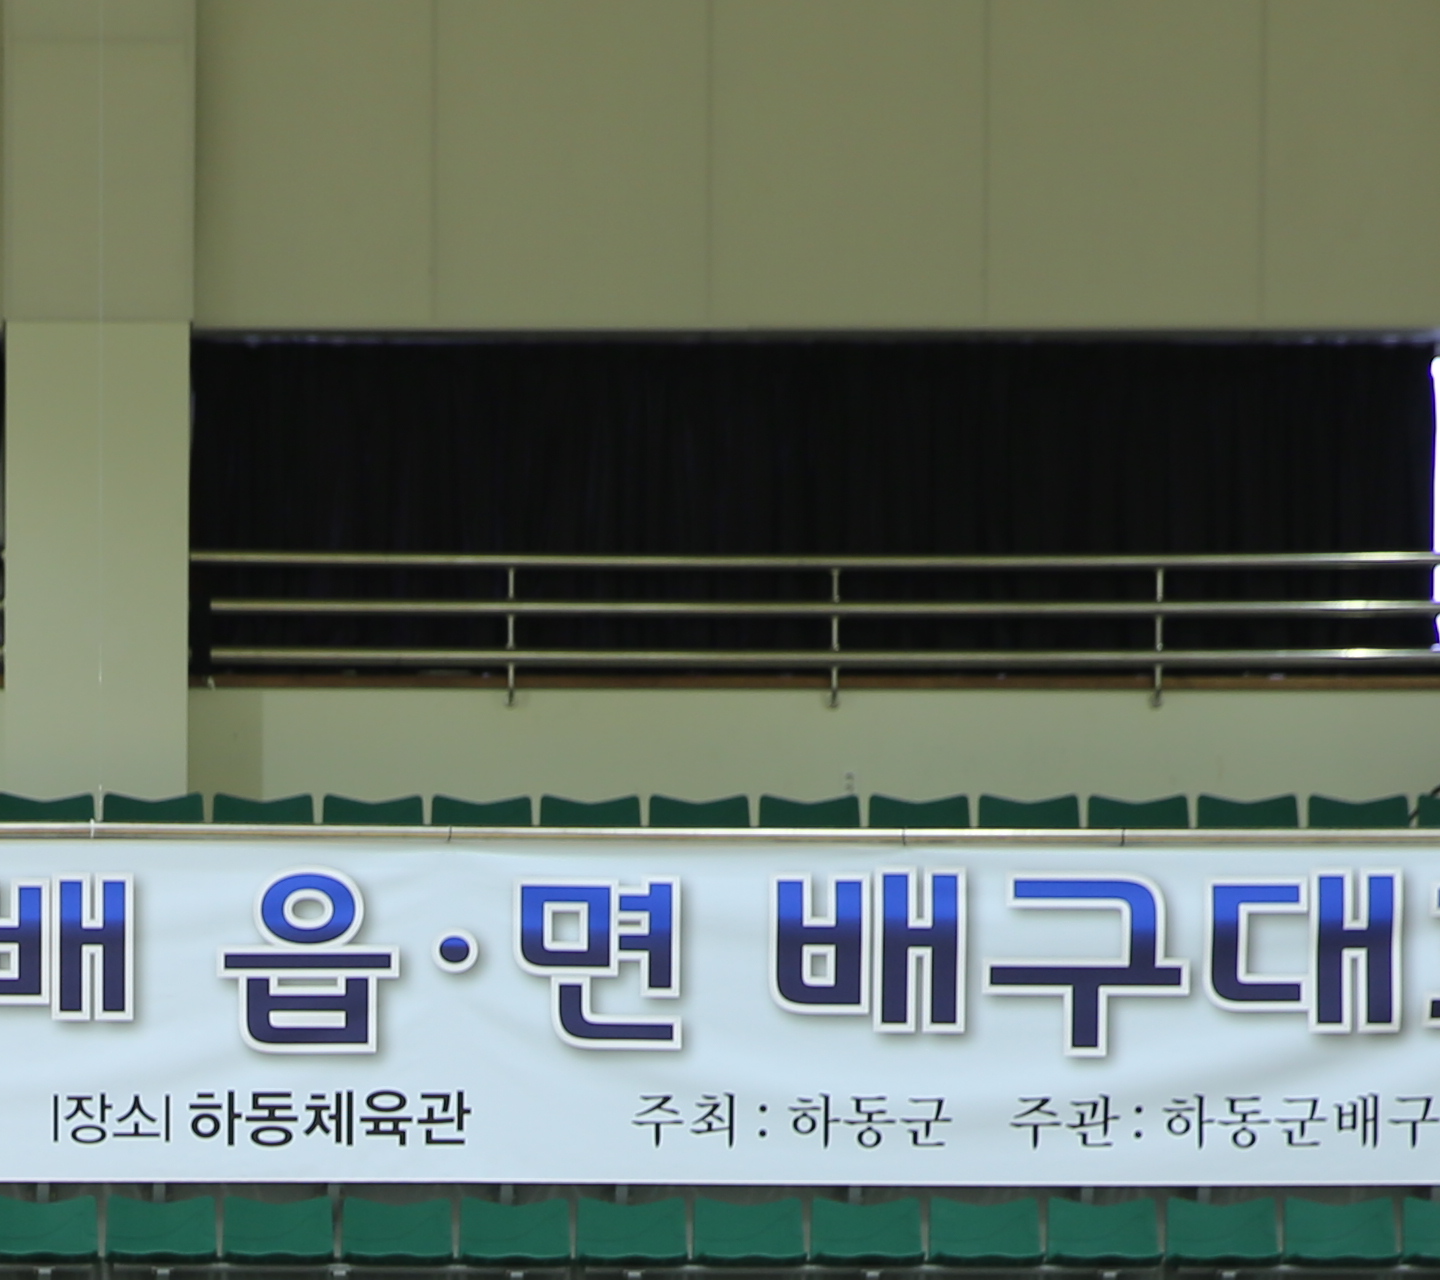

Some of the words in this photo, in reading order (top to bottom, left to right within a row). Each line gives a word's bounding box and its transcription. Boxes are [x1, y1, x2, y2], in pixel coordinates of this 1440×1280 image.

[222, 870, 676, 1046] 읍·면
[188, 1089, 472, 1148] 하동체육관
[630, 1091, 735, 1150] 주최
[786, 1092, 953, 1150] 하동군
[1008, 1092, 1121, 1150] 주관
